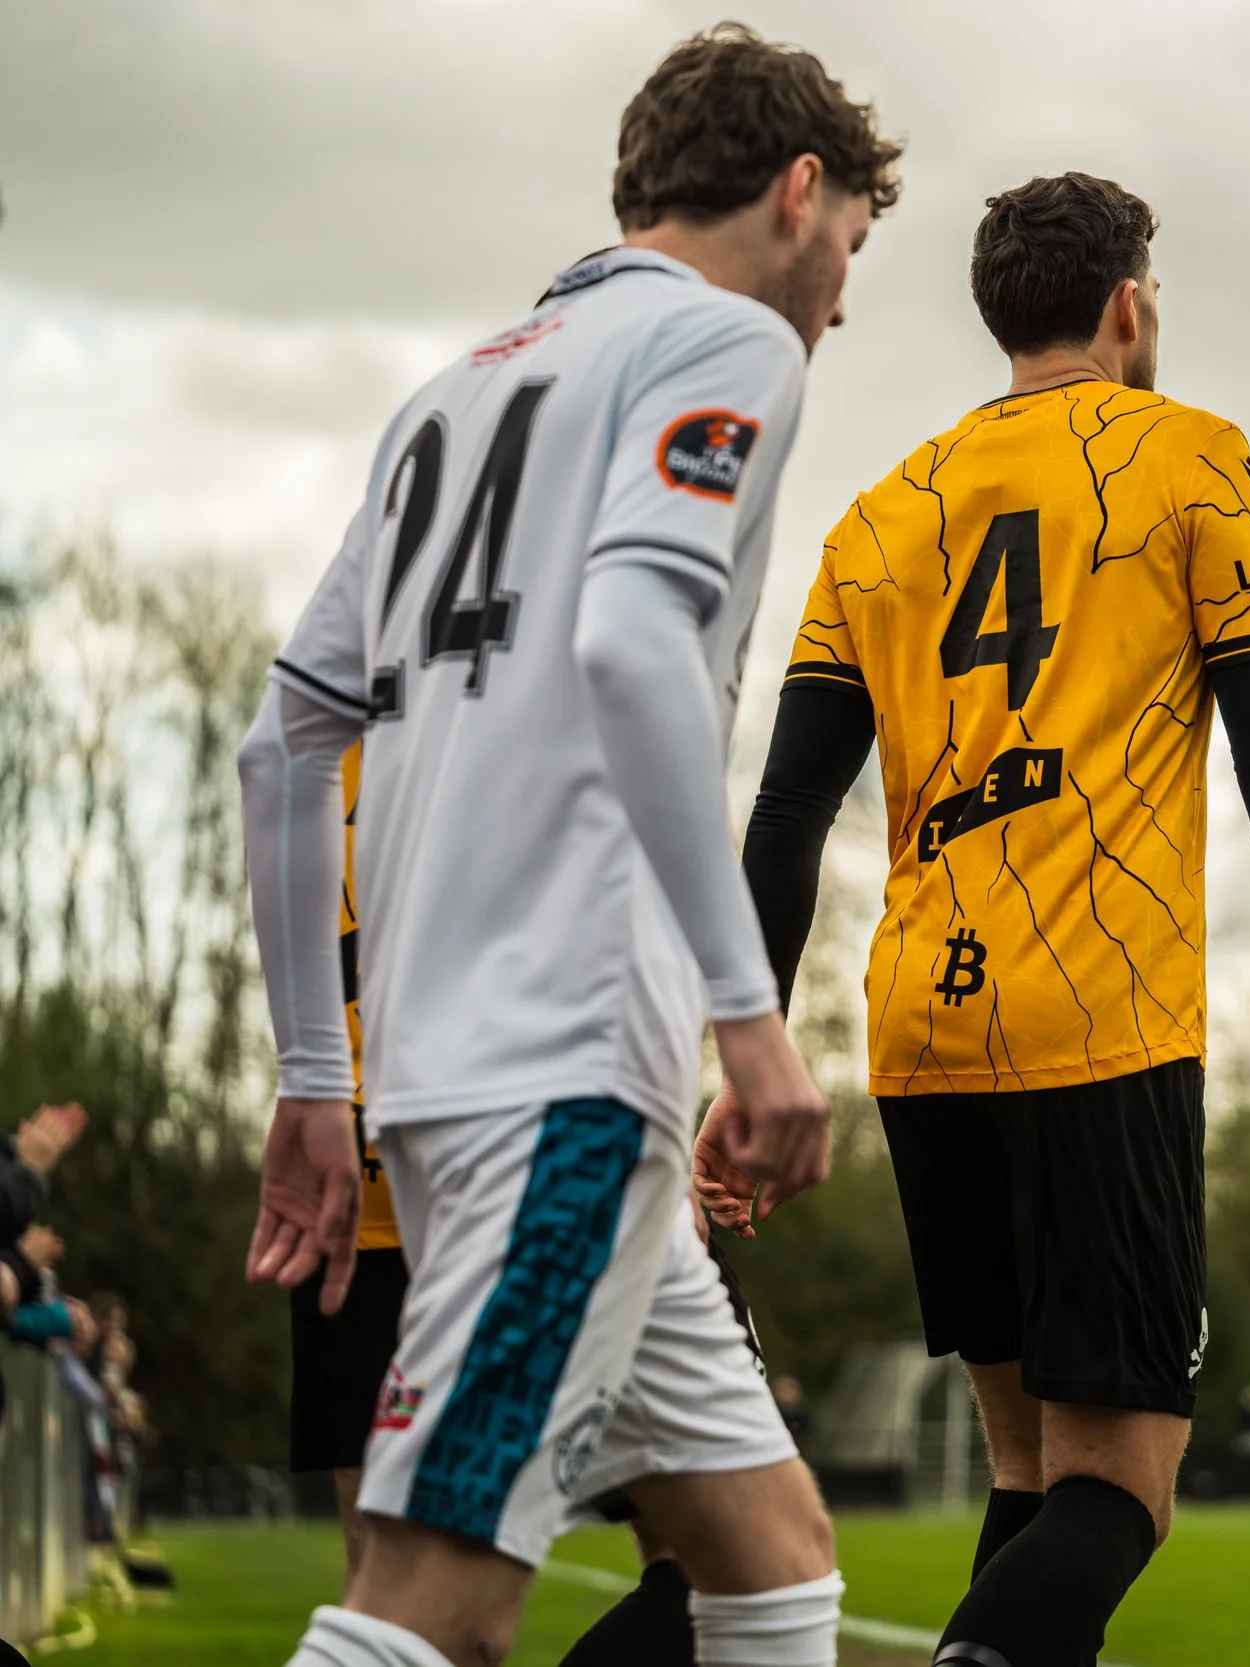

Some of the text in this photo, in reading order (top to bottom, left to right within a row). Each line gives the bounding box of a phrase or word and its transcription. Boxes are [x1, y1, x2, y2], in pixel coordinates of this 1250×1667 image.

[364, 375, 557, 727] 24
[938, 508, 1061, 711] 4
[928, 759, 1044, 851] IEN
